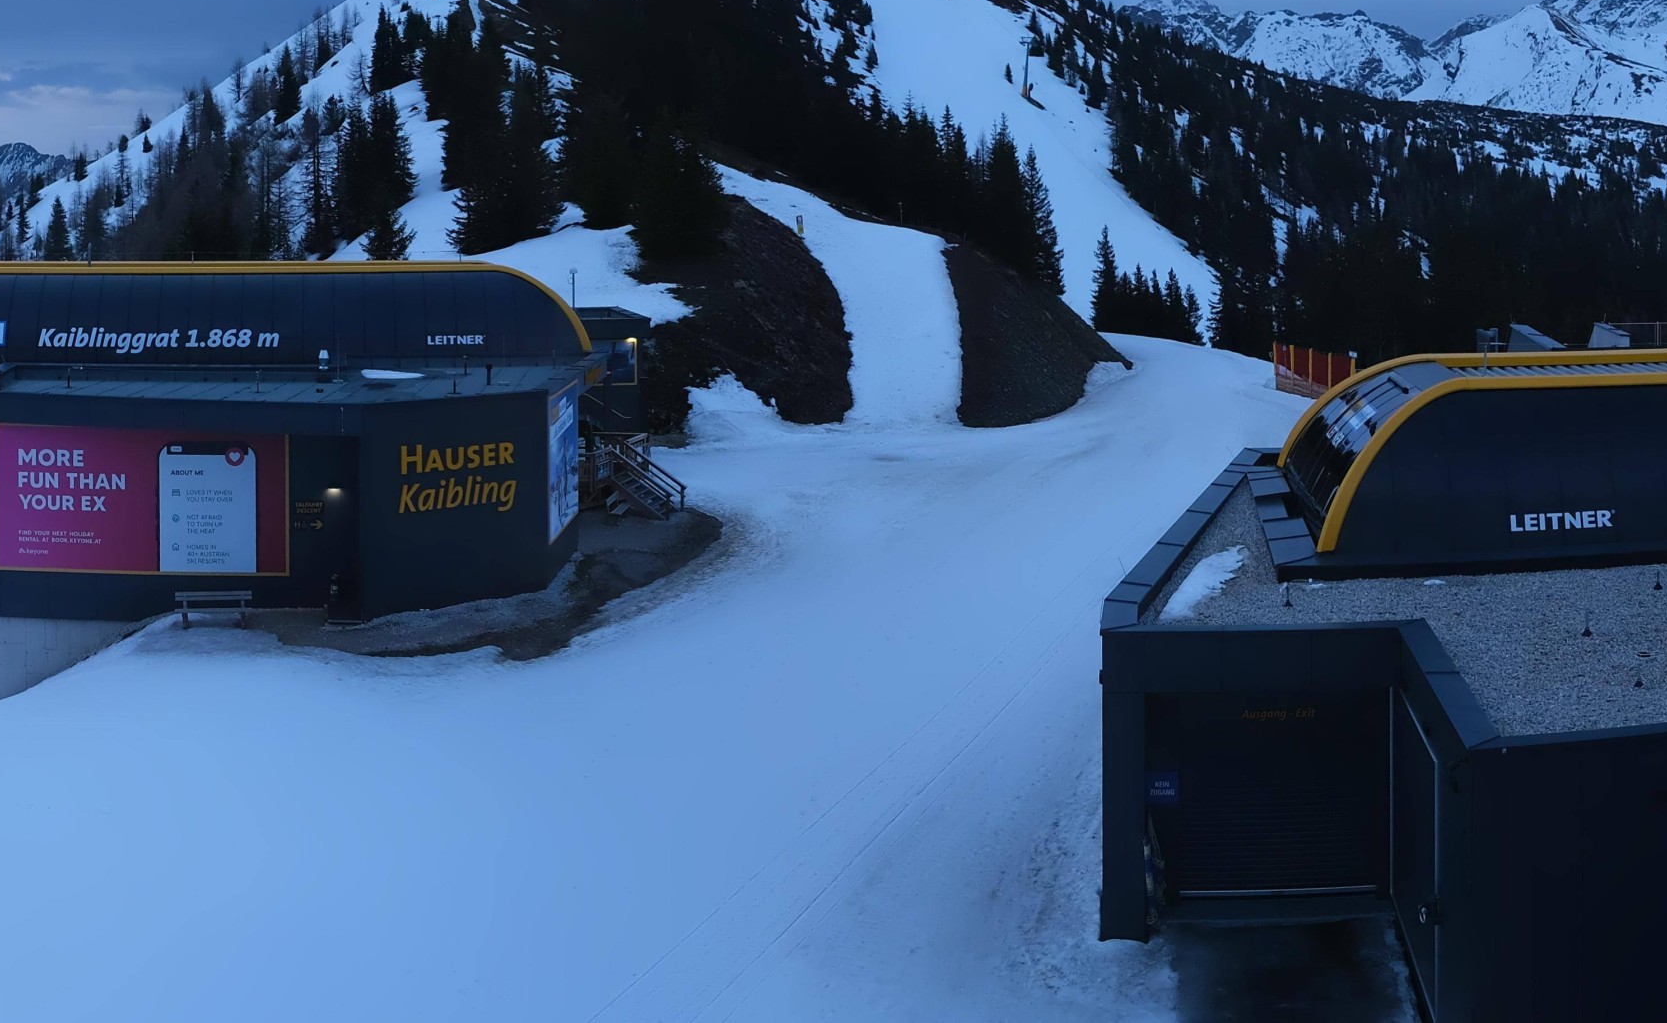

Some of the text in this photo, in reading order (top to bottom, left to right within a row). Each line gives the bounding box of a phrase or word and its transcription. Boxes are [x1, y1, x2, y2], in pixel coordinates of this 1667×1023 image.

[37, 327, 280, 355] Kaiblinggrat 1.868 m
[17, 448, 85, 467] MORE
[400, 441, 515, 475] HAUSER
[17, 471, 126, 490] FUN THAN
[19, 493, 107, 513] YOUR EX
[398, 475, 517, 514] Kaibling
[26, 548, 49, 556] keyone
[1241, 709, 1288, 721] Ausgang
[1295, 707, 1317, 718] Exit
[1149, 788, 1175, 796] ZUGANG
[1154, 780, 1170, 788] KEIN
